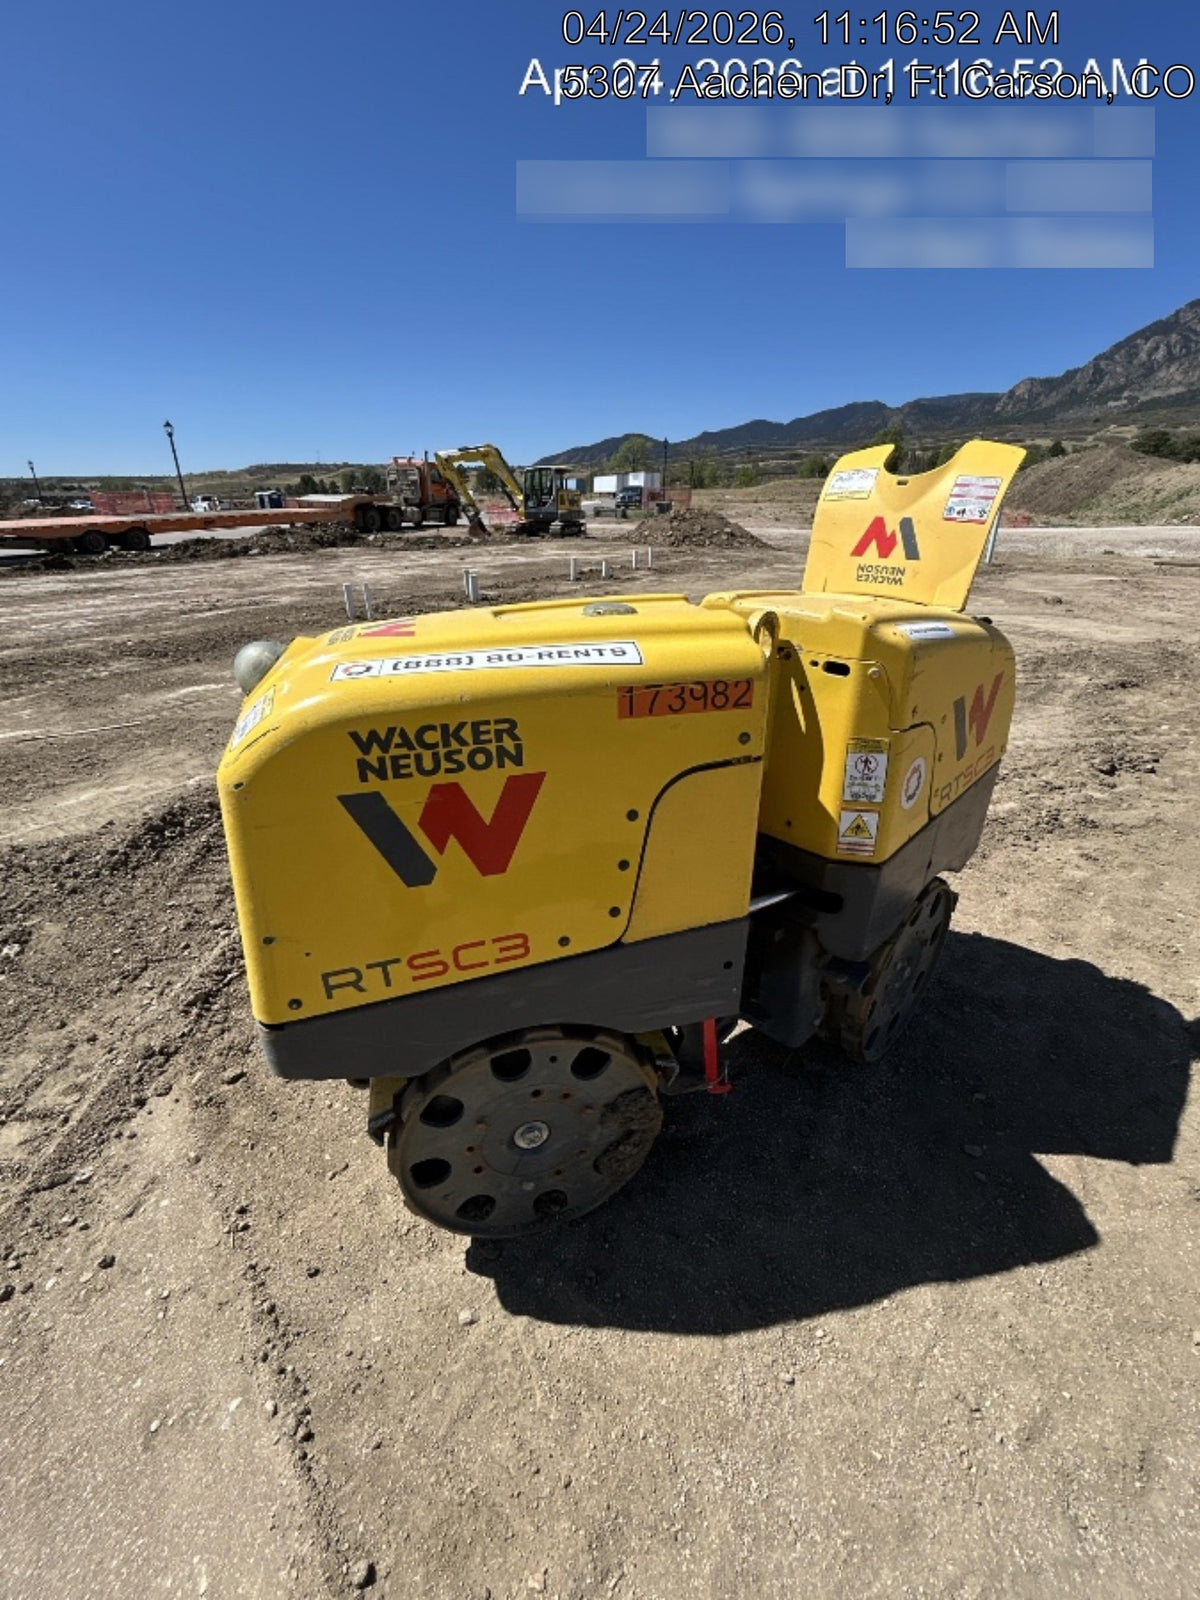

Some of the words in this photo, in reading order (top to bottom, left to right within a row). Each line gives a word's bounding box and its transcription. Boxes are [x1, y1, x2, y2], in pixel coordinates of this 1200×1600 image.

[622, 677, 753, 716] 173982
[347, 717, 522, 756] WACKER
[356, 743, 524, 783] NEUSON
